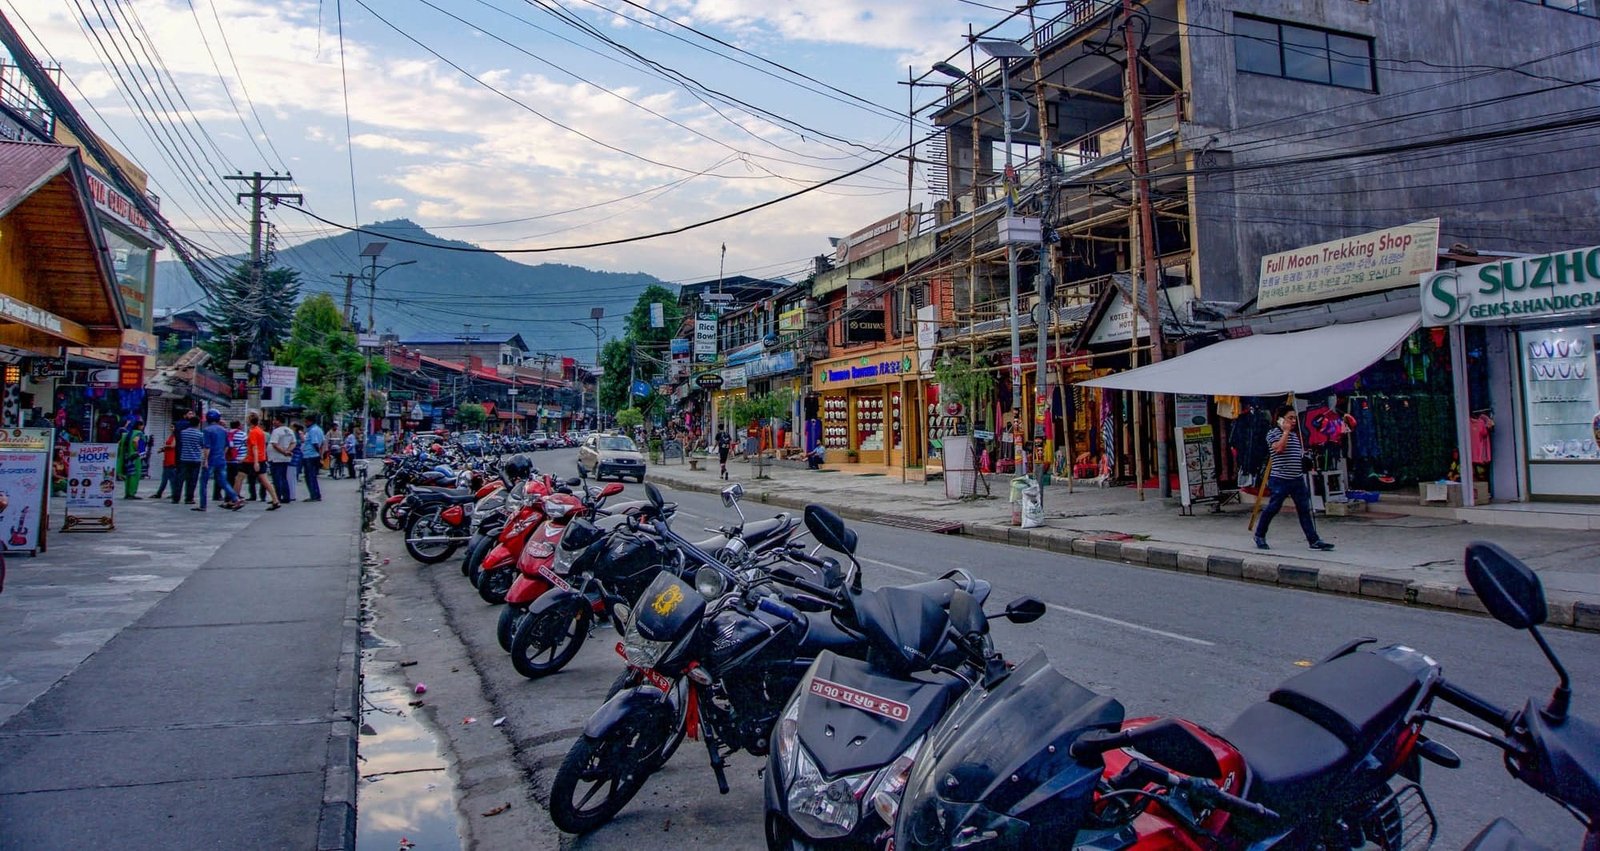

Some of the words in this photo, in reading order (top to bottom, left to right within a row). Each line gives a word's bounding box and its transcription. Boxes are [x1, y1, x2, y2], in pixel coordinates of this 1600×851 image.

[1266, 256, 1285, 274] Full
[1287, 254, 1319, 270] Moon
[1323, 241, 1375, 263] Trekking
[1379, 232, 1412, 252] Shop
[699, 323, 715, 331] Rice
[860, 322, 886, 330] CHIVAS
[1119, 320, 1134, 328] HOTE
[697, 332, 716, 340] Bowl
[80, 446, 108, 454] HAPPY
[78, 452, 109, 461] HOUR
[637, 620, 655, 637] HONDA
[714, 638, 743, 652] HONDA
[903, 645, 926, 660] HONDA
